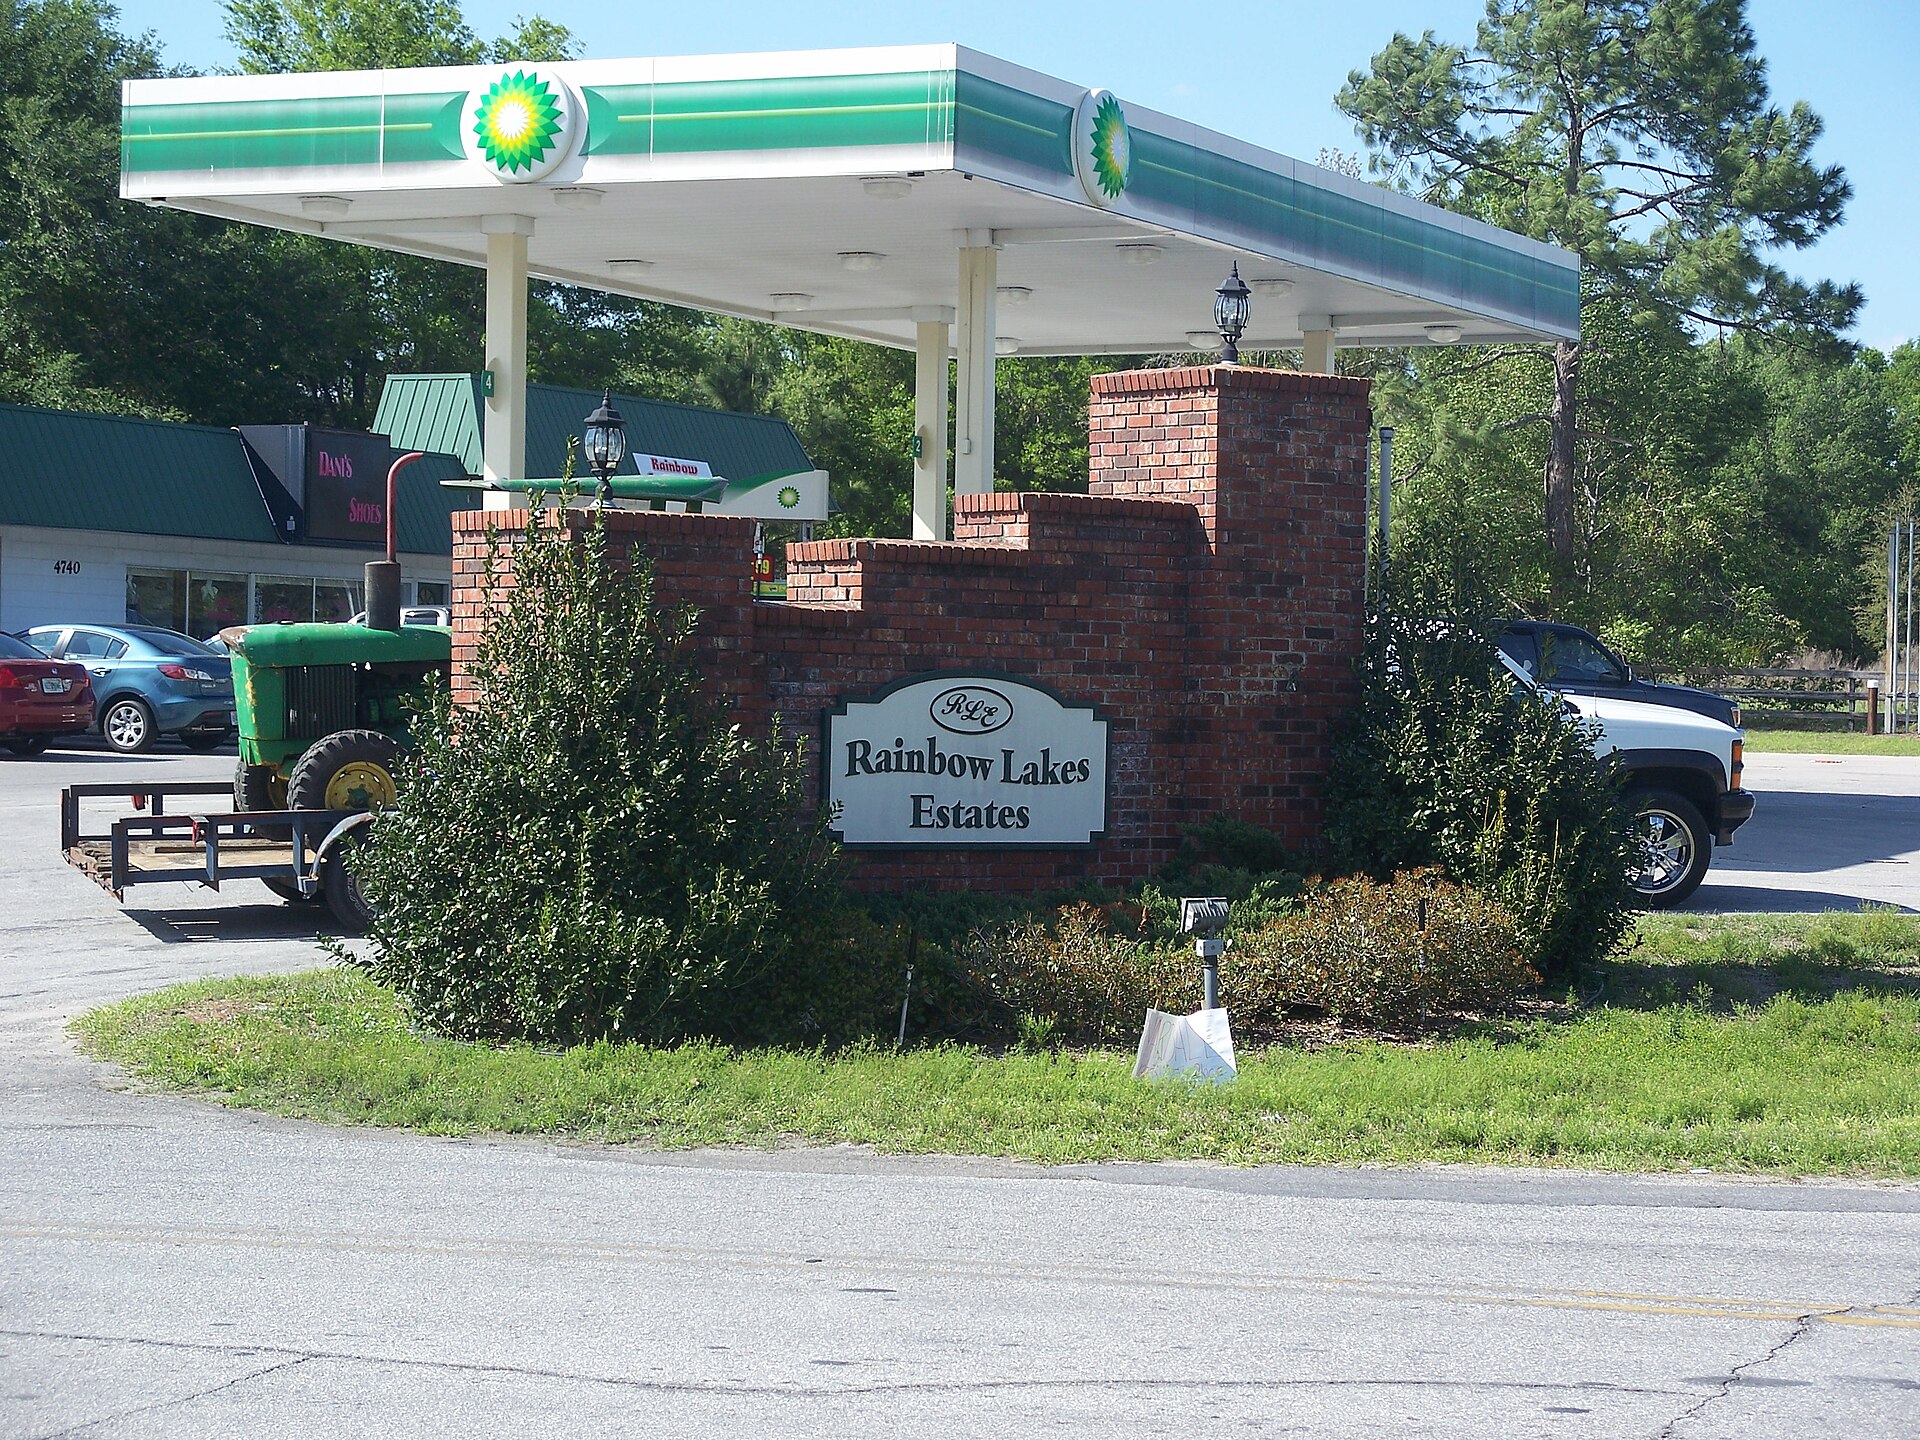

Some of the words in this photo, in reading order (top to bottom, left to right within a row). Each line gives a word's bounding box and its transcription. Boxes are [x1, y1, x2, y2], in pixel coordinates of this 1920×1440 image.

[485, 374, 492, 390] 4
[915, 439, 921, 452] 2
[651, 457, 698, 475] Rainbow
[349, 497, 382, 523] SHOES
[53, 560, 81, 575] 4740
[844, 736, 995, 781] Rainbow
[1000, 747, 1090, 785] Lakes
[909, 794, 1030, 829] Estates
